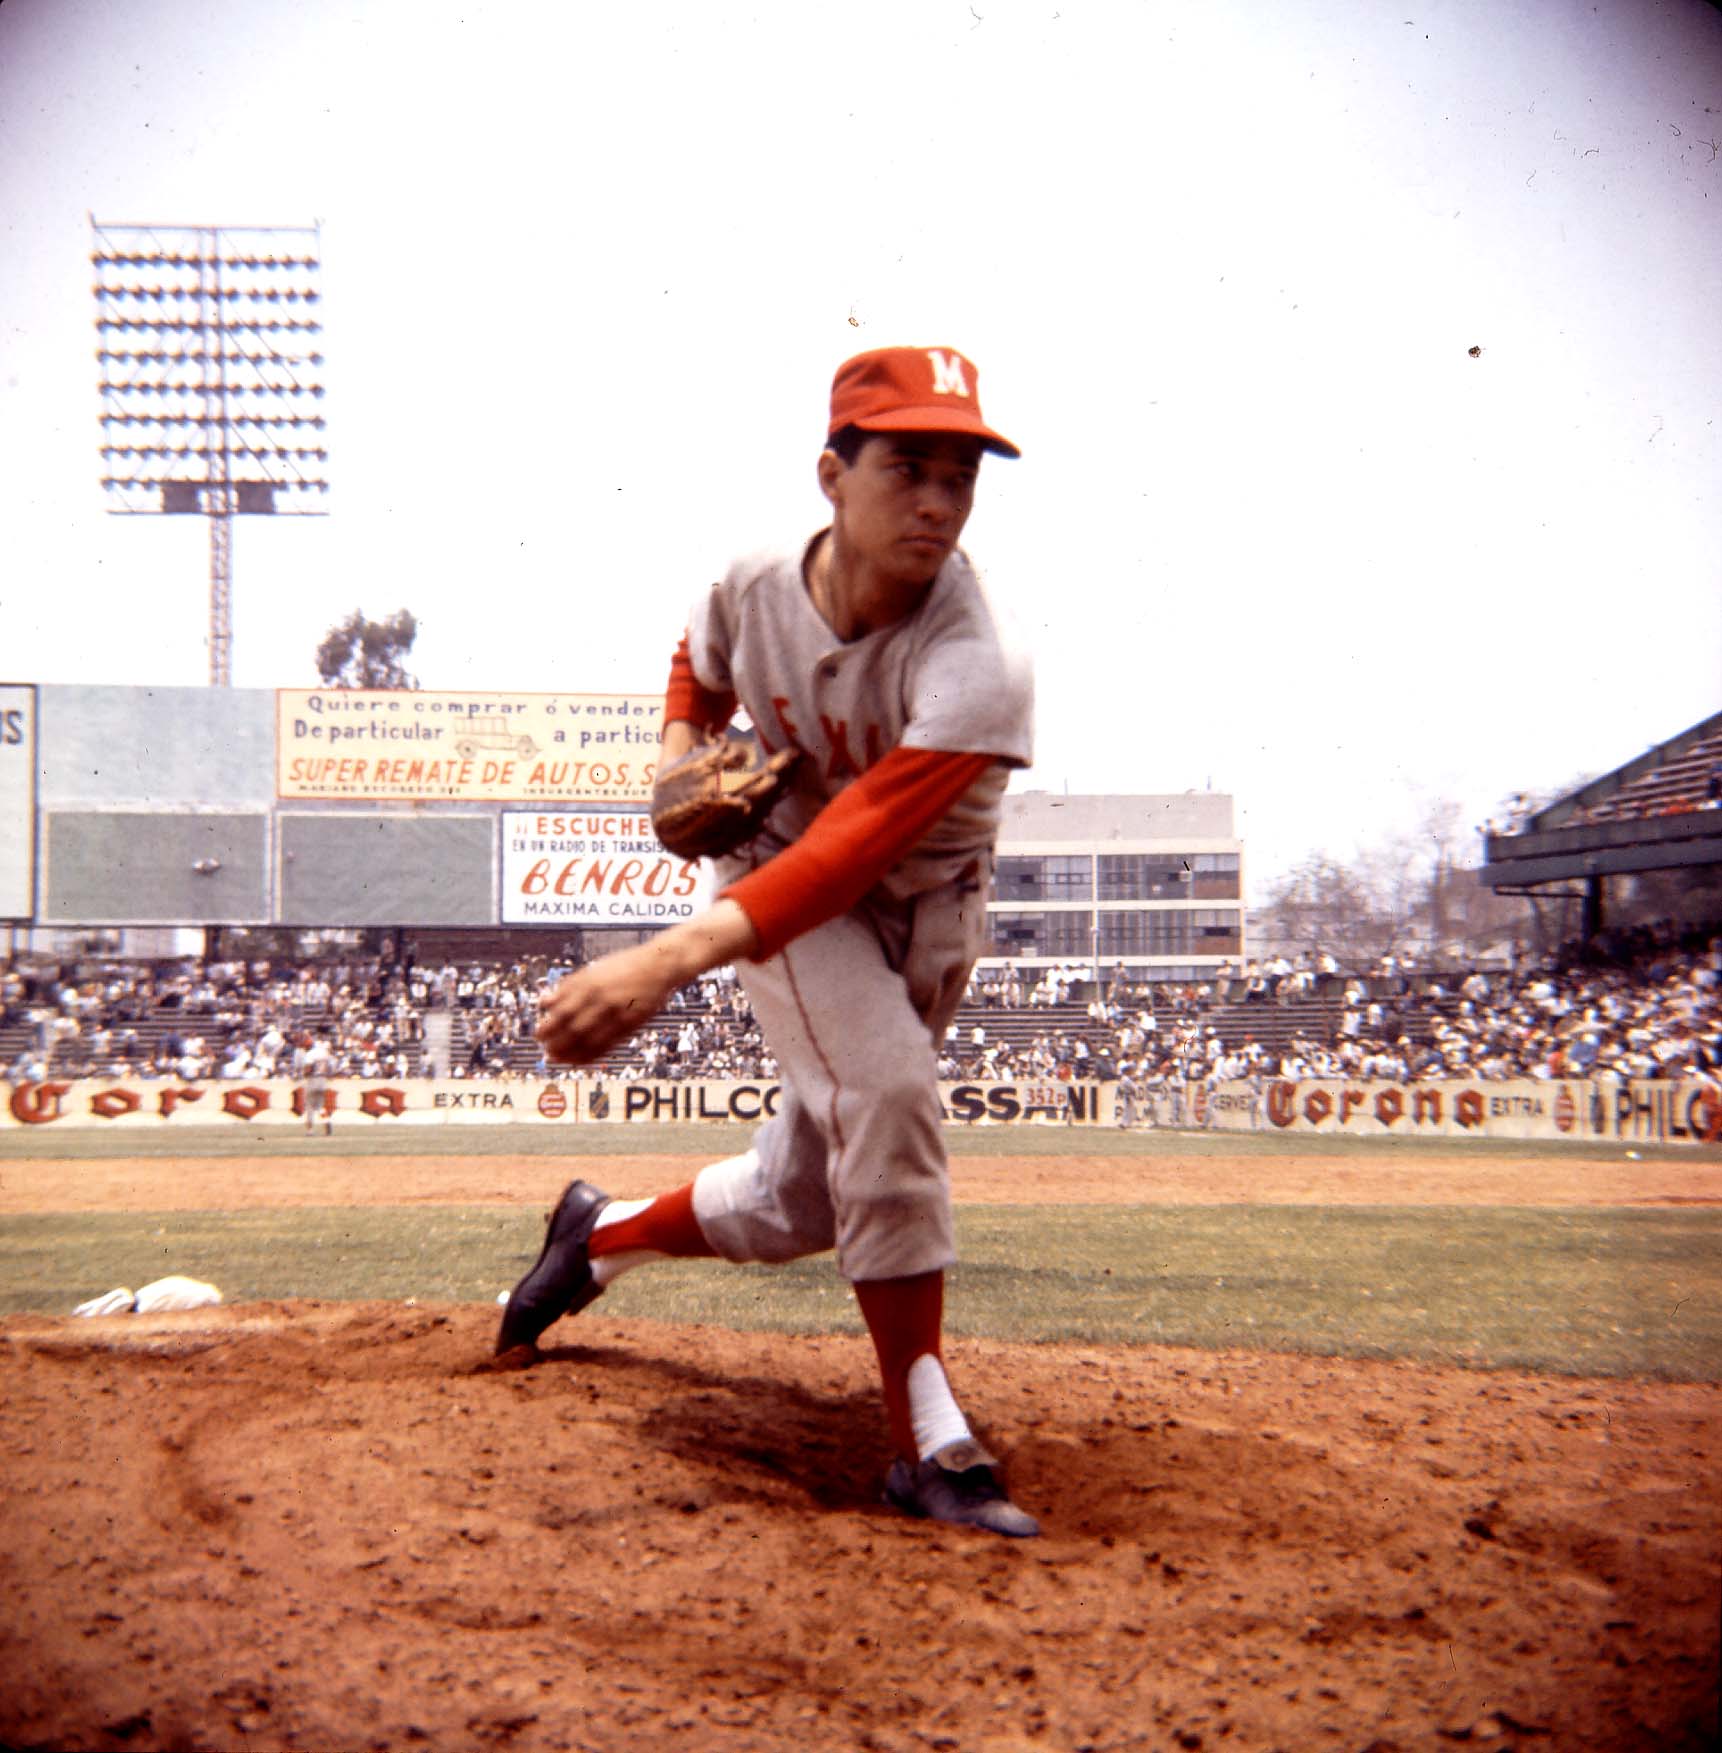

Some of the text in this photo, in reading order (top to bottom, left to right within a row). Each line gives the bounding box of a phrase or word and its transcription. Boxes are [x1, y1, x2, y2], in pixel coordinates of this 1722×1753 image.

[928, 350, 970, 398] M
[308, 695, 400, 713] Quiere
[414, 701, 527, 719] comprar
[569, 701, 660, 716] vender
[0, 710, 24, 745] S
[295, 719, 323, 738] De
[329, 721, 443, 744] particular
[554, 730, 565, 743] a
[289, 757, 368, 781] SUPER
[374, 758, 475, 785] REMATE
[481, 761, 516, 785] DE
[551, 840, 585, 853] RADIO
[592, 841, 606, 853] DE
[521, 858, 697, 896] BENROS
[524, 902, 694, 917] MAXIMA CALIDAD
[10, 1080, 408, 1124] Corona
[433, 1093, 514, 1109] EXTRA
[1267, 1081, 1485, 1128] Corona
[1491, 1097, 1543, 1117] EXTRA
